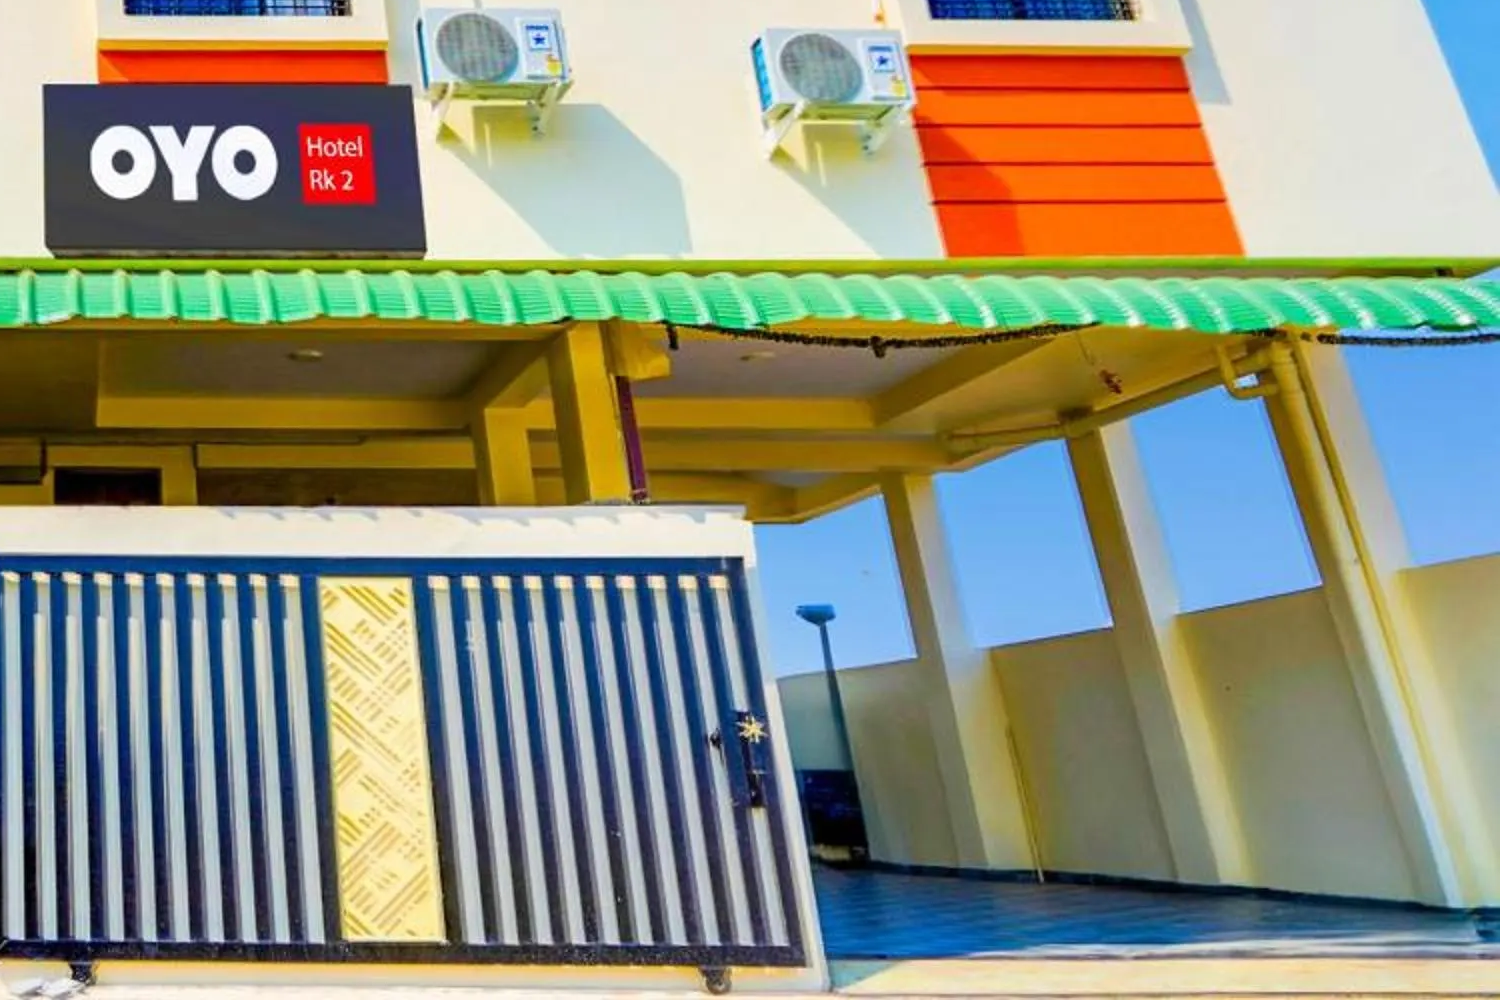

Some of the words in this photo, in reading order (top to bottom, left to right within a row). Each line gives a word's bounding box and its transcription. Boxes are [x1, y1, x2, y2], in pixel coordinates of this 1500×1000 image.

[306, 136, 363, 158] Hotel
[90, 125, 278, 201] OYO
[309, 168, 336, 191] Rk
[340, 169, 355, 191] 2
